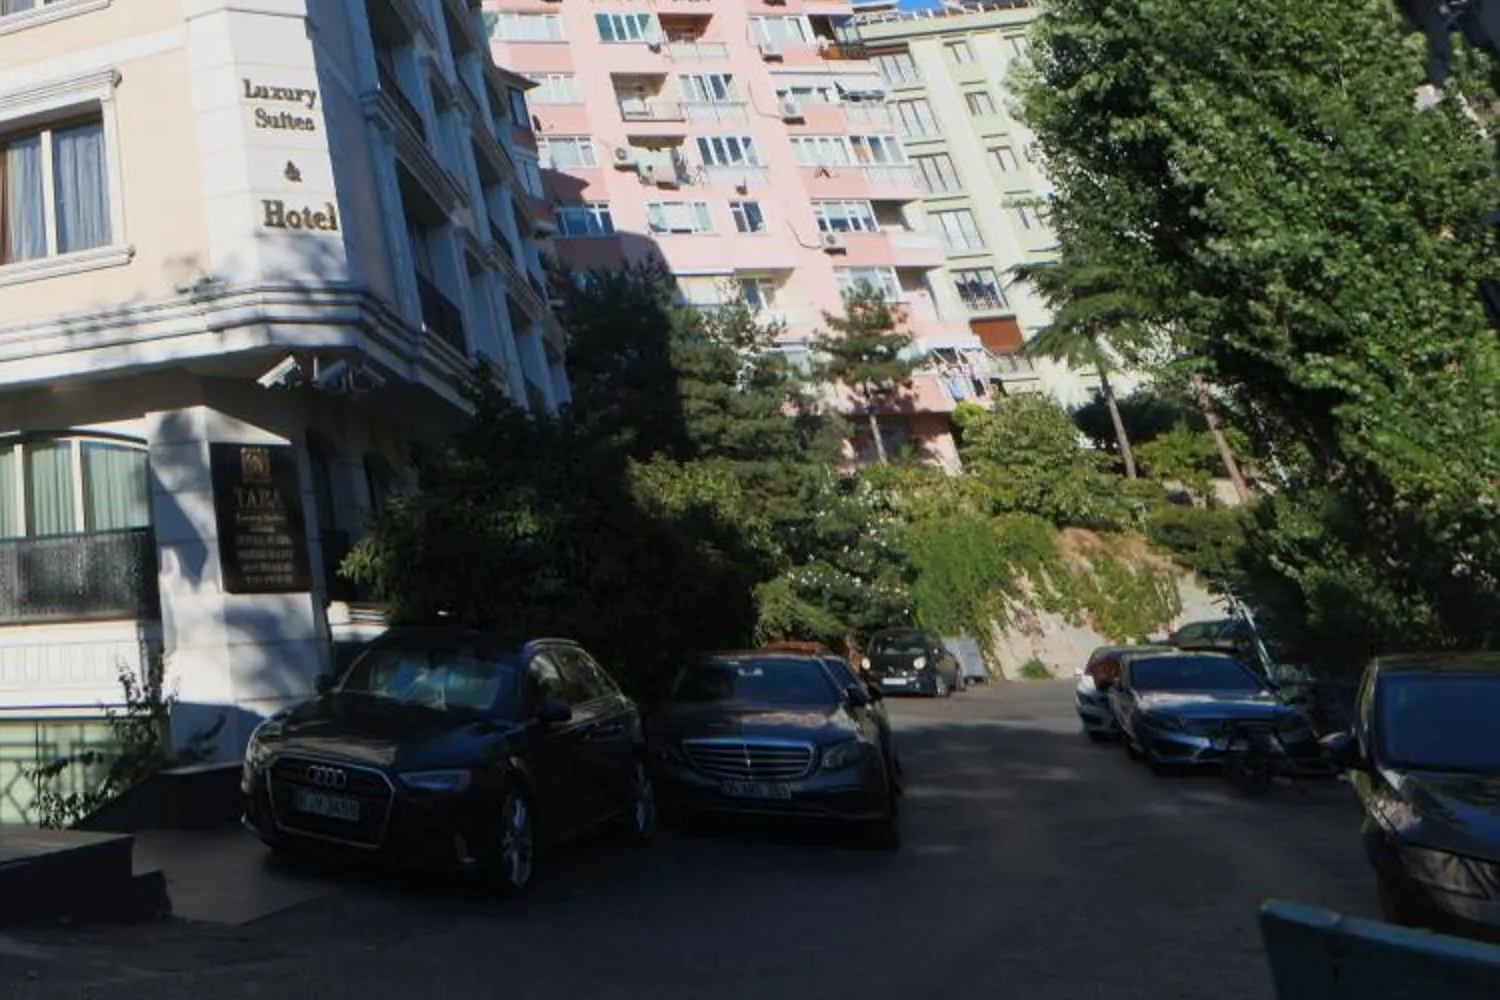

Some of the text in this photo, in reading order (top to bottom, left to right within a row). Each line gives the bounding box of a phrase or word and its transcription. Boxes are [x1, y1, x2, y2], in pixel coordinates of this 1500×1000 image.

[243, 78, 317, 109] Luxury
[255, 107, 315, 131] Suites
[284, 160, 303, 183] &
[260, 199, 338, 231] Hotel
